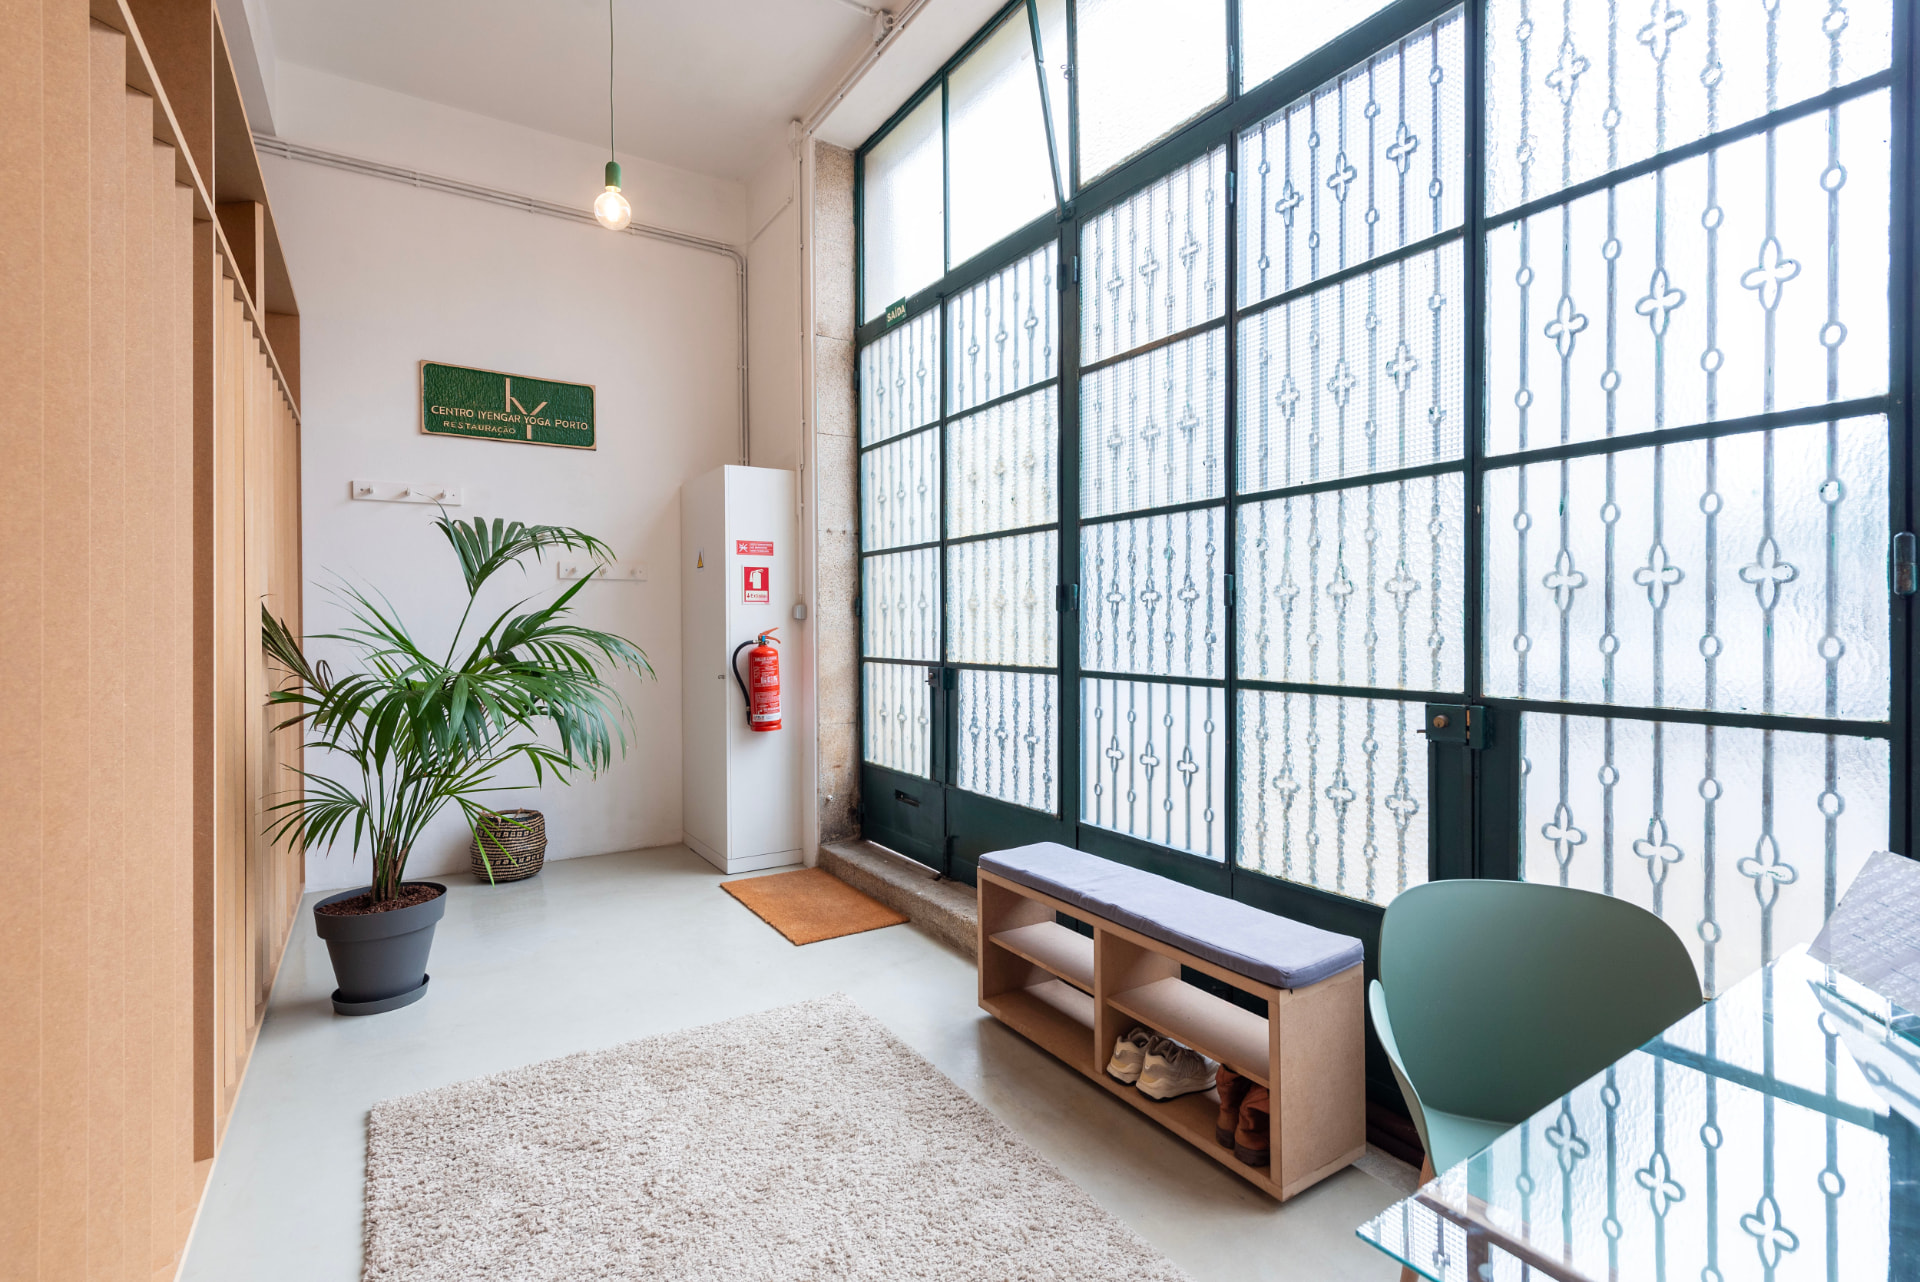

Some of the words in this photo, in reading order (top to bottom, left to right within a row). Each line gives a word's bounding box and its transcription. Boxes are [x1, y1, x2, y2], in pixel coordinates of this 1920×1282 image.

[431, 405, 474, 418] CENTRO
[478, 411, 521, 423] IYENGAR
[524, 416, 551, 426] YOGA
[555, 419, 588, 431] PORTO
[443, 421, 516, 436] RESTAURAÇÃO
